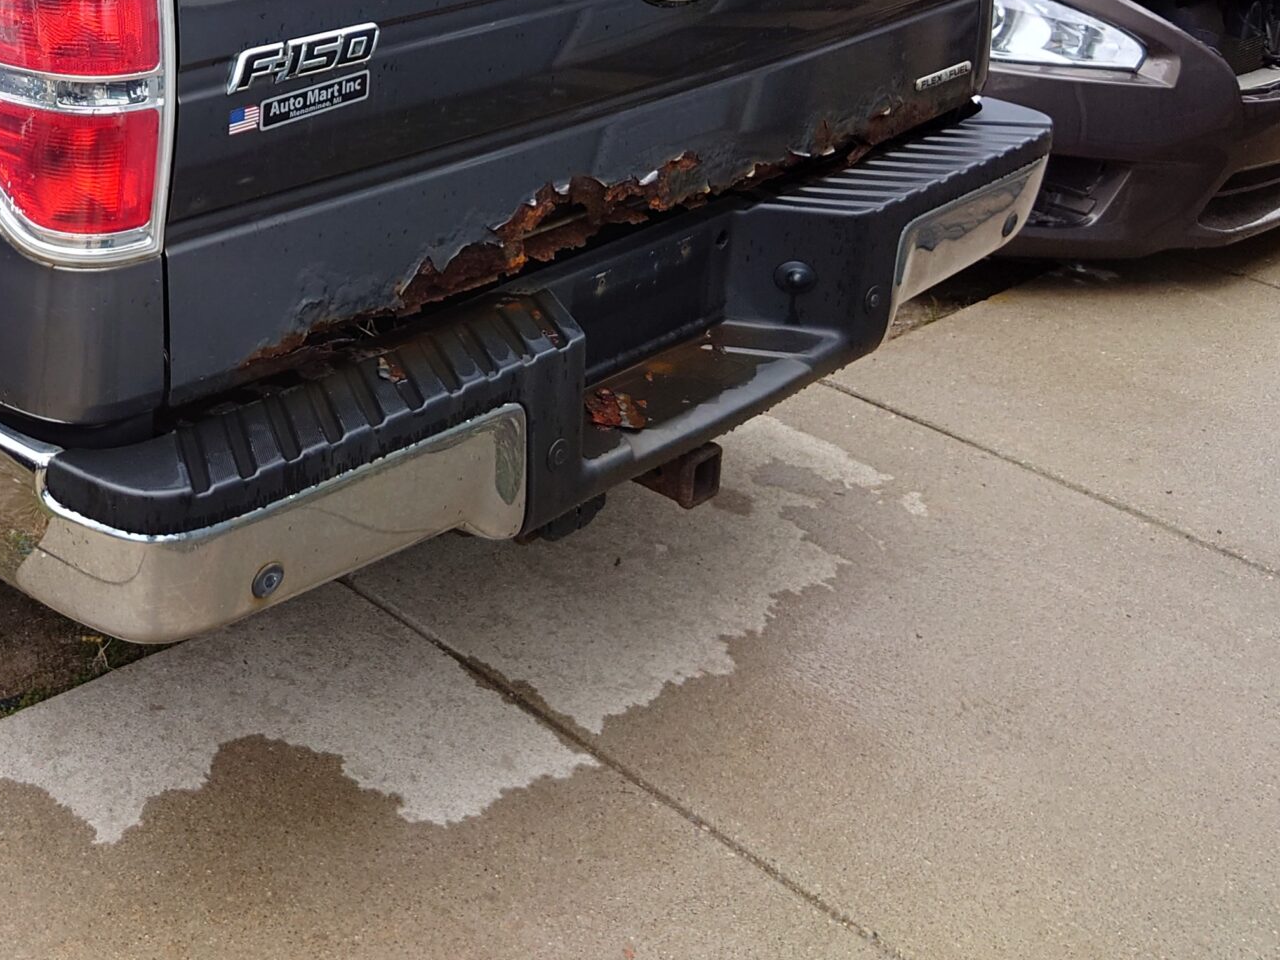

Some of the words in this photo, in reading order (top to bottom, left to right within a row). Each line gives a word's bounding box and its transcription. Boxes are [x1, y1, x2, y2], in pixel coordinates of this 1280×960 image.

[226, 21, 380, 95] F-150
[921, 74, 943, 89] FLEX
[949, 65, 968, 79] FUEL
[269, 94, 304, 116] Auto
[306, 85, 340, 105] Mart
[341, 77, 362, 93] Inc
